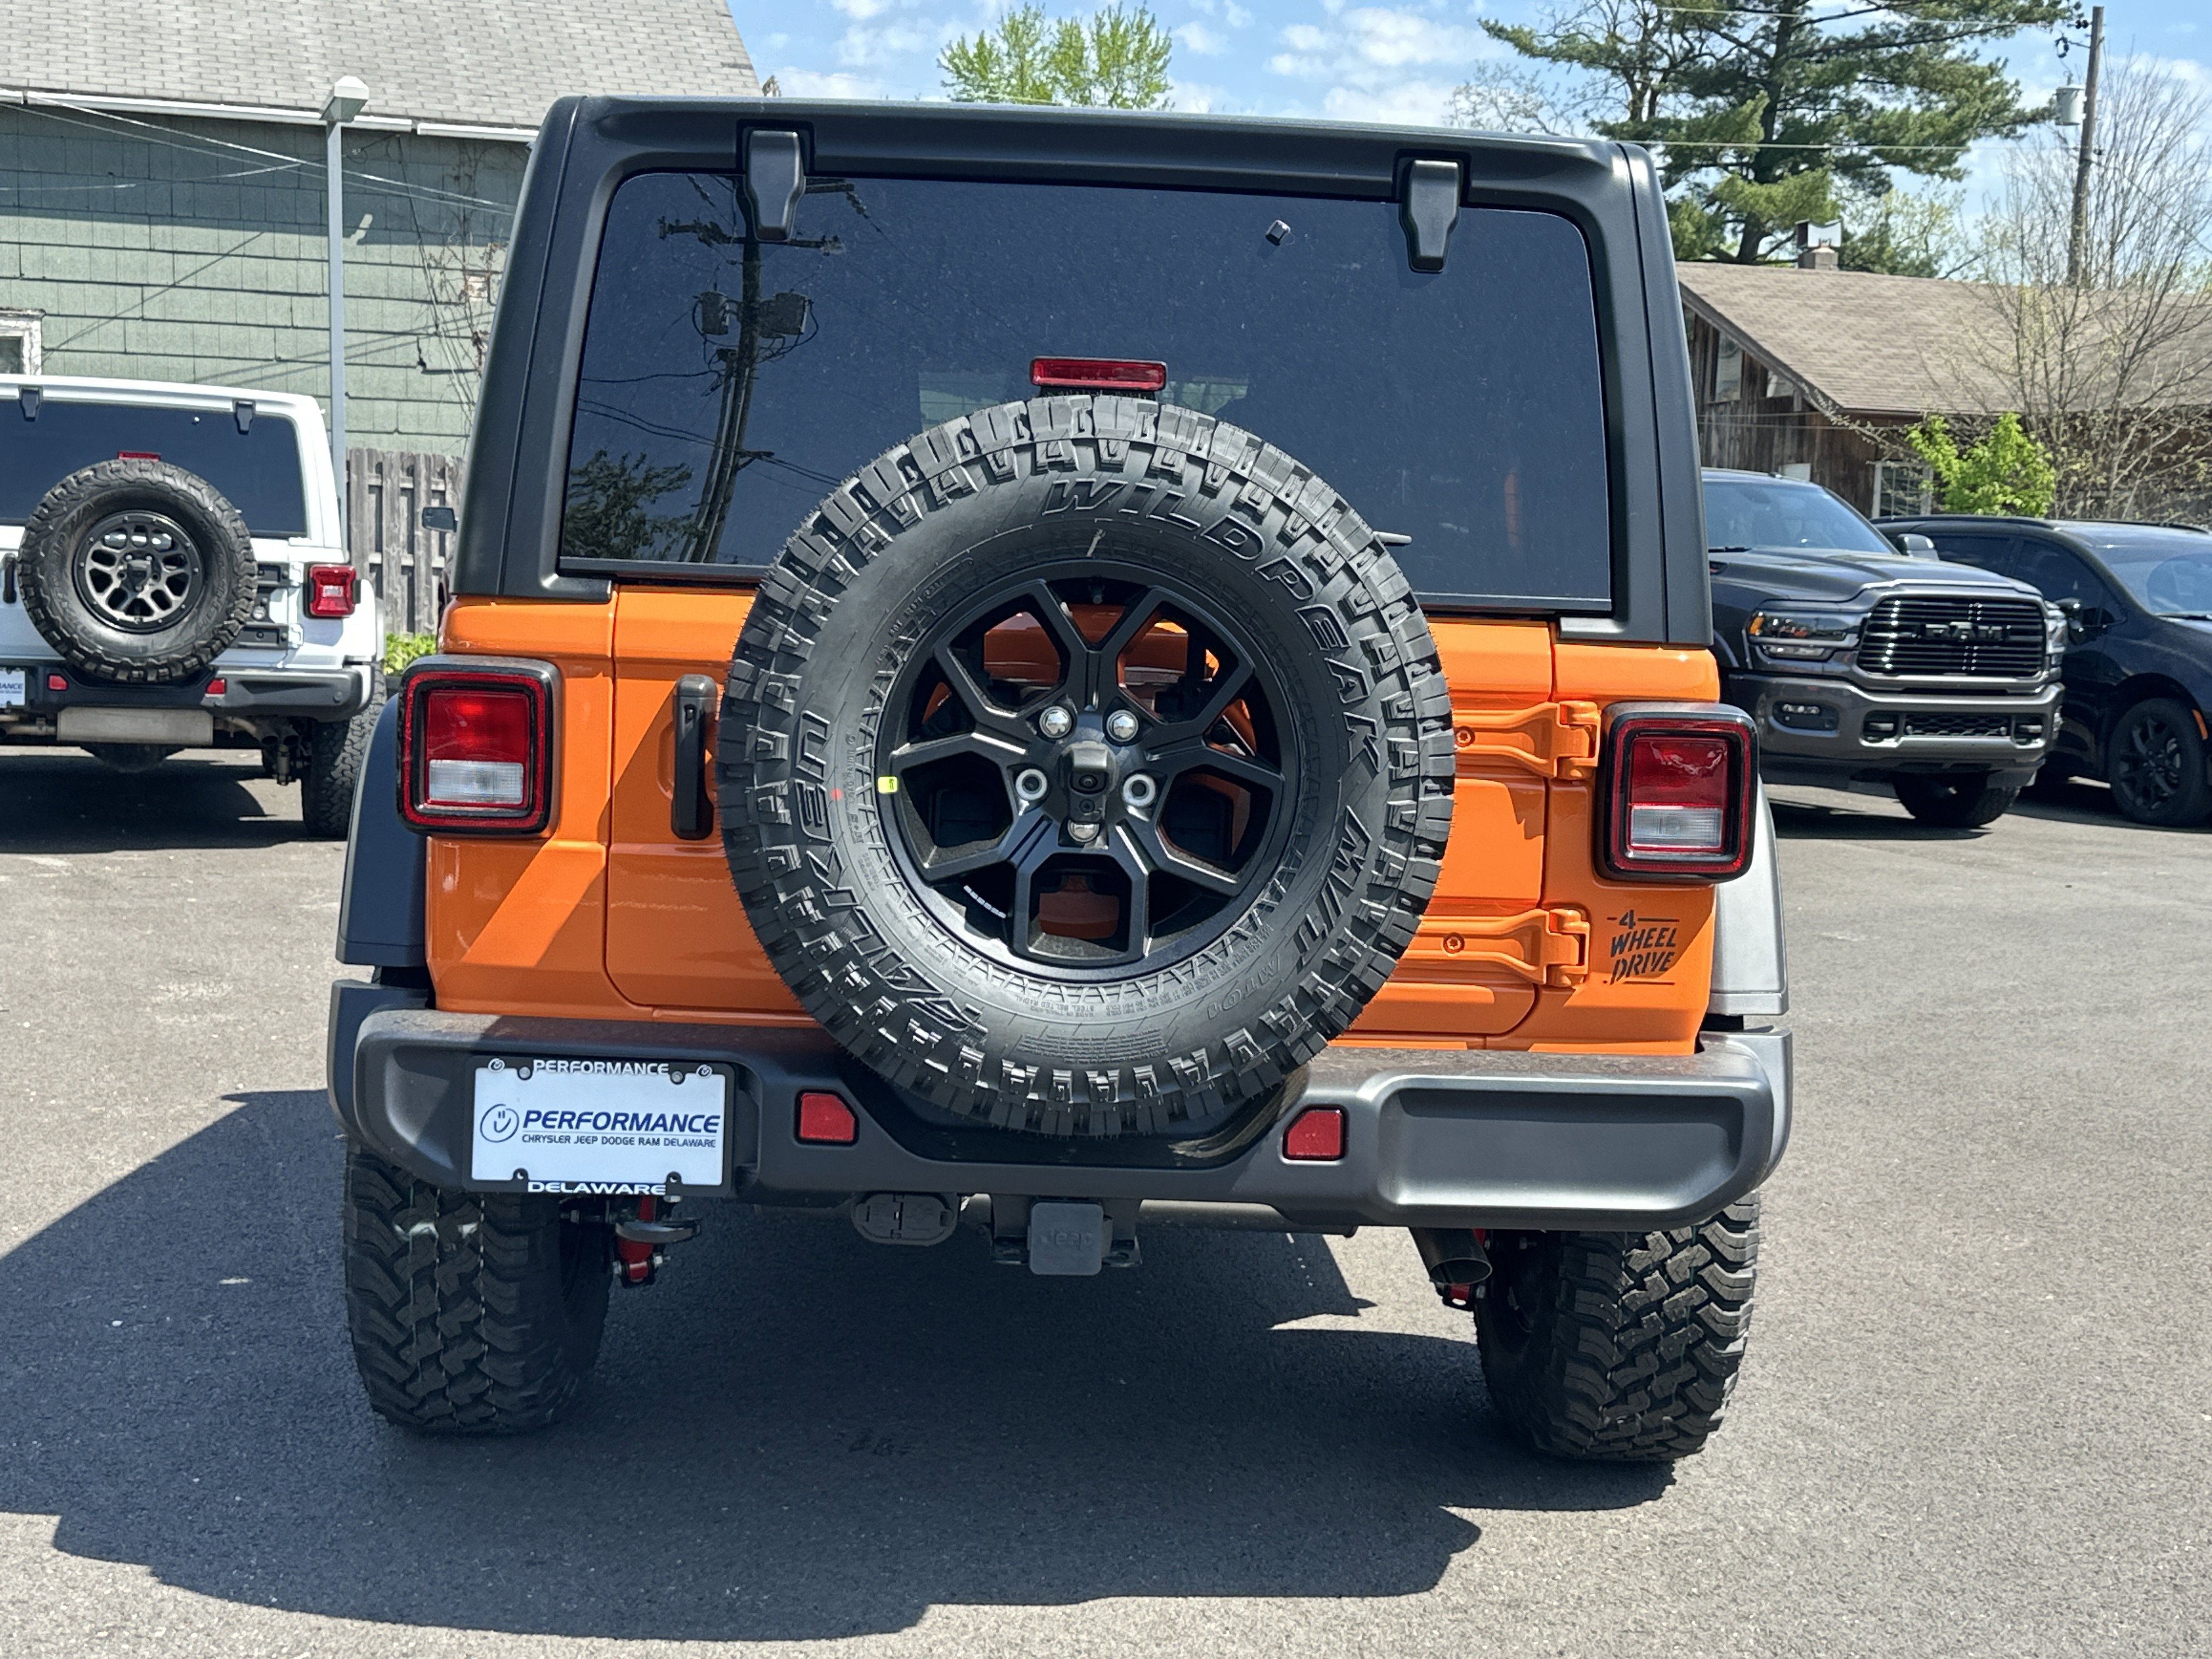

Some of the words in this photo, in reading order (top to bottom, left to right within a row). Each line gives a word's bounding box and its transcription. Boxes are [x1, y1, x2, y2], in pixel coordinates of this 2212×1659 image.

[1042, 478, 1380, 761] WILDPEAK
[1925, 622, 2004, 641] RAM
[797, 711, 990, 1032] FALKEN
[1298, 805, 1372, 961] M/T
[1619, 910, 1636, 929] 4
[1610, 927, 1677, 957] WHEEL
[1610, 951, 1675, 985] DRIVE
[533, 1059, 669, 1075] PERFORMANCE
[523, 1110, 721, 1133] PERFORMANCE
[522, 1134, 571, 1144] CHRYSLER
[574, 1135, 598, 1145] JEEP
[602, 1136, 635, 1146] DODGE
[638, 1137, 661, 1146] RAM
[664, 1138, 716, 1148] DELAWARE
[528, 1182, 667, 1195] DELAWARE
